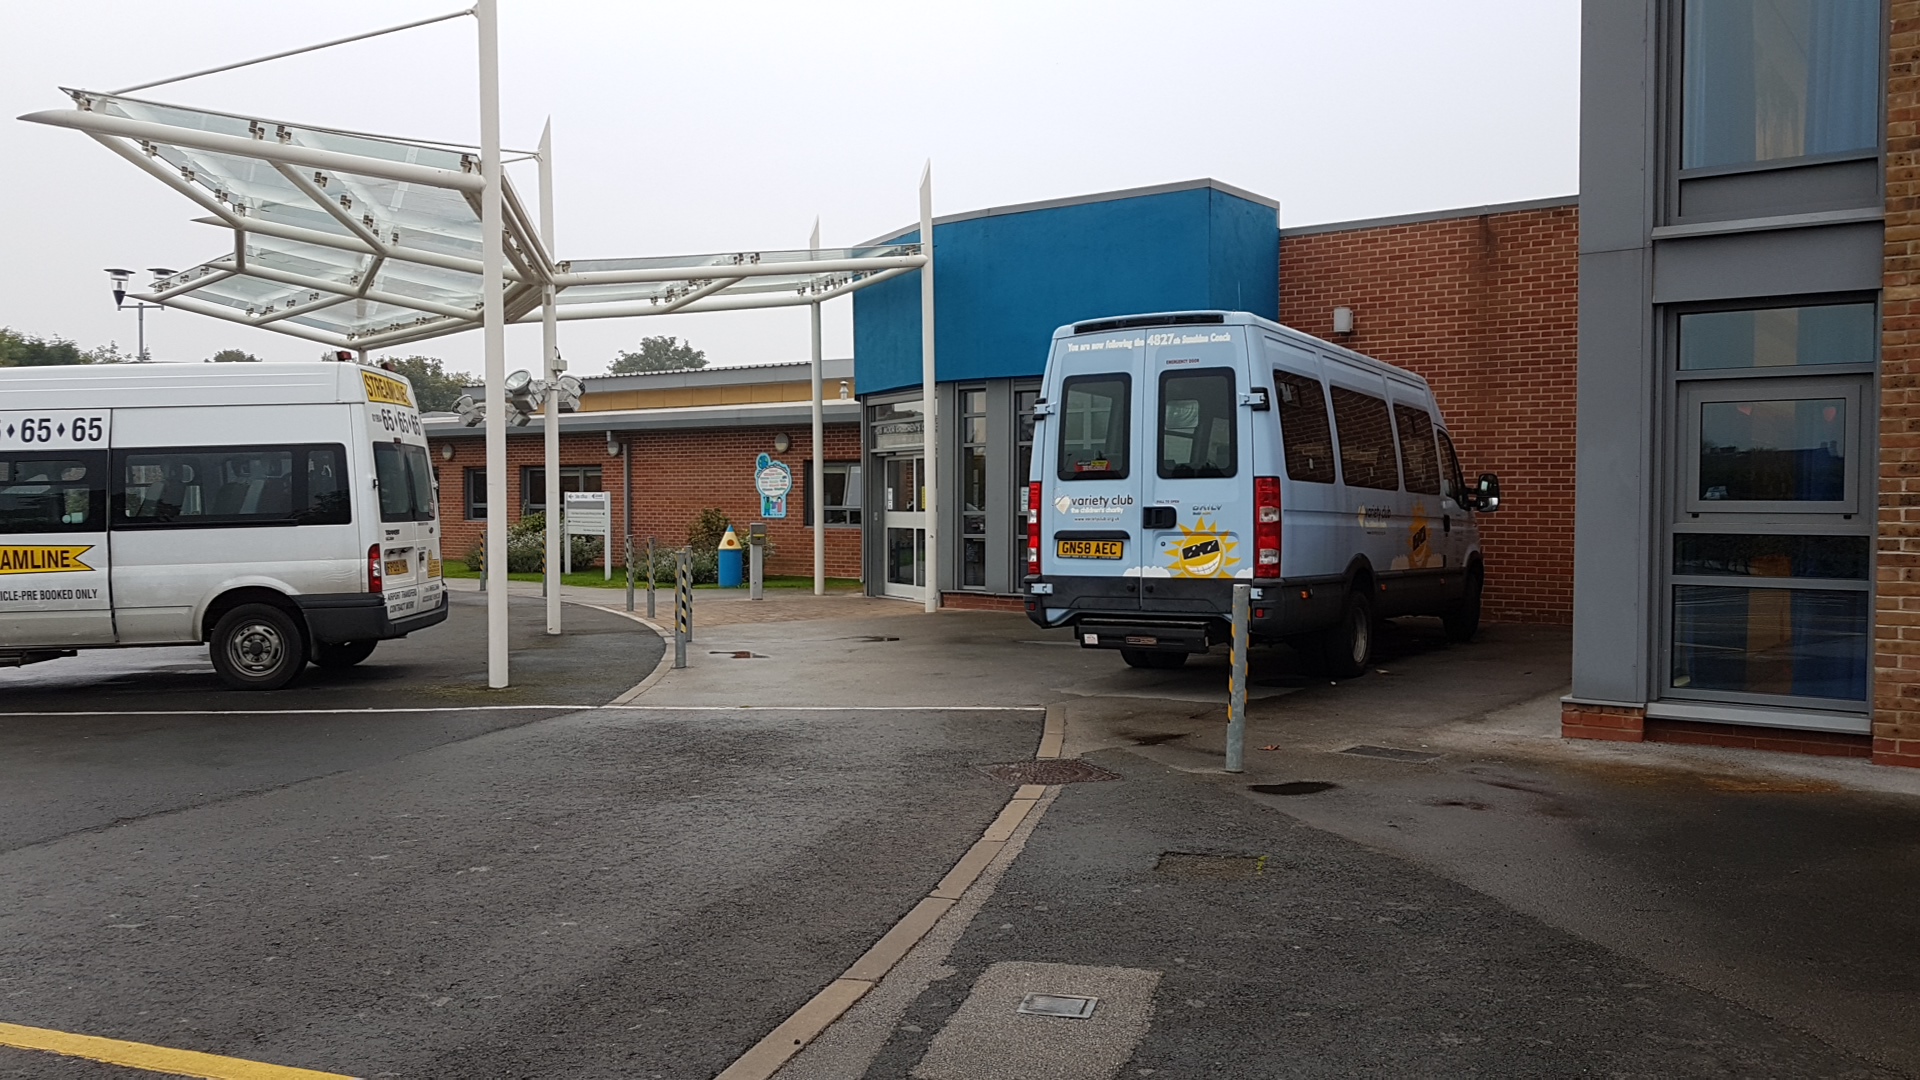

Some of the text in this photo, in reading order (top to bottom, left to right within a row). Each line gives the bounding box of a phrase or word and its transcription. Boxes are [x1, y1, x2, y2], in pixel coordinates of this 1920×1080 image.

[1067, 343, 1079, 352] You
[1091, 342, 1105, 350] now
[1106, 339, 1133, 350] following
[1134, 338, 1145, 347] the
[1182, 333, 1209, 344] Sunshine
[1210, 332, 1231, 342] Coach
[364, 374, 407, 403] STREAMLINE
[20, 418, 51, 443] 65
[72, 417, 102, 442] 65
[381, 408, 395, 432] 65
[398, 411, 410, 434] 65
[410, 414, 421, 436] 65
[1071, 494, 1134, 508] variety club
[1062, 542, 1118, 555] GN58 AEC
[0, 550, 71, 570] AMLINE
[40, 589, 74, 600] BOOKED
[76, 588, 98, 600] ONLY
